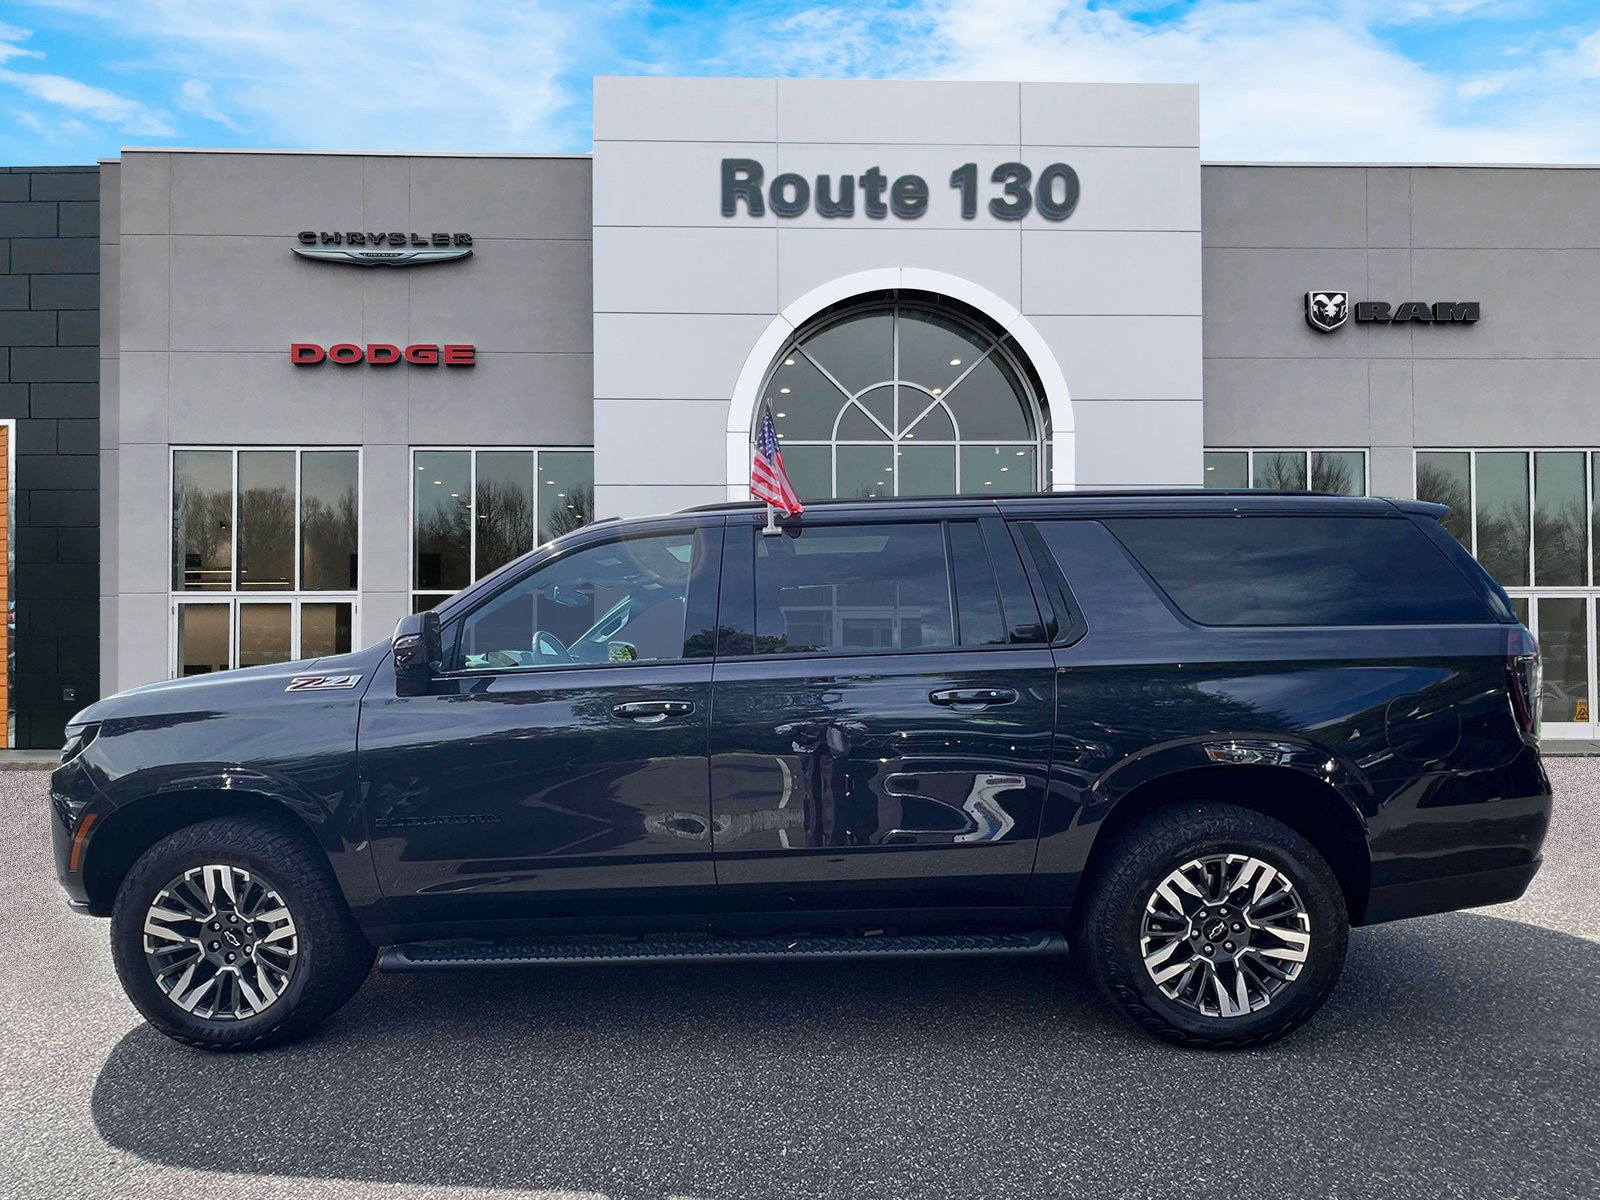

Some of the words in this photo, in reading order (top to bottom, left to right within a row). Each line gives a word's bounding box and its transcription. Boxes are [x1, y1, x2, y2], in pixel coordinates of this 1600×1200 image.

[721, 158, 929, 218] Route
[950, 162, 1080, 221] 130
[298, 231, 473, 245] CHRYSLER
[1355, 301, 1480, 324] RAM
[291, 343, 475, 366] DODGE
[284, 674, 363, 692] Z71
